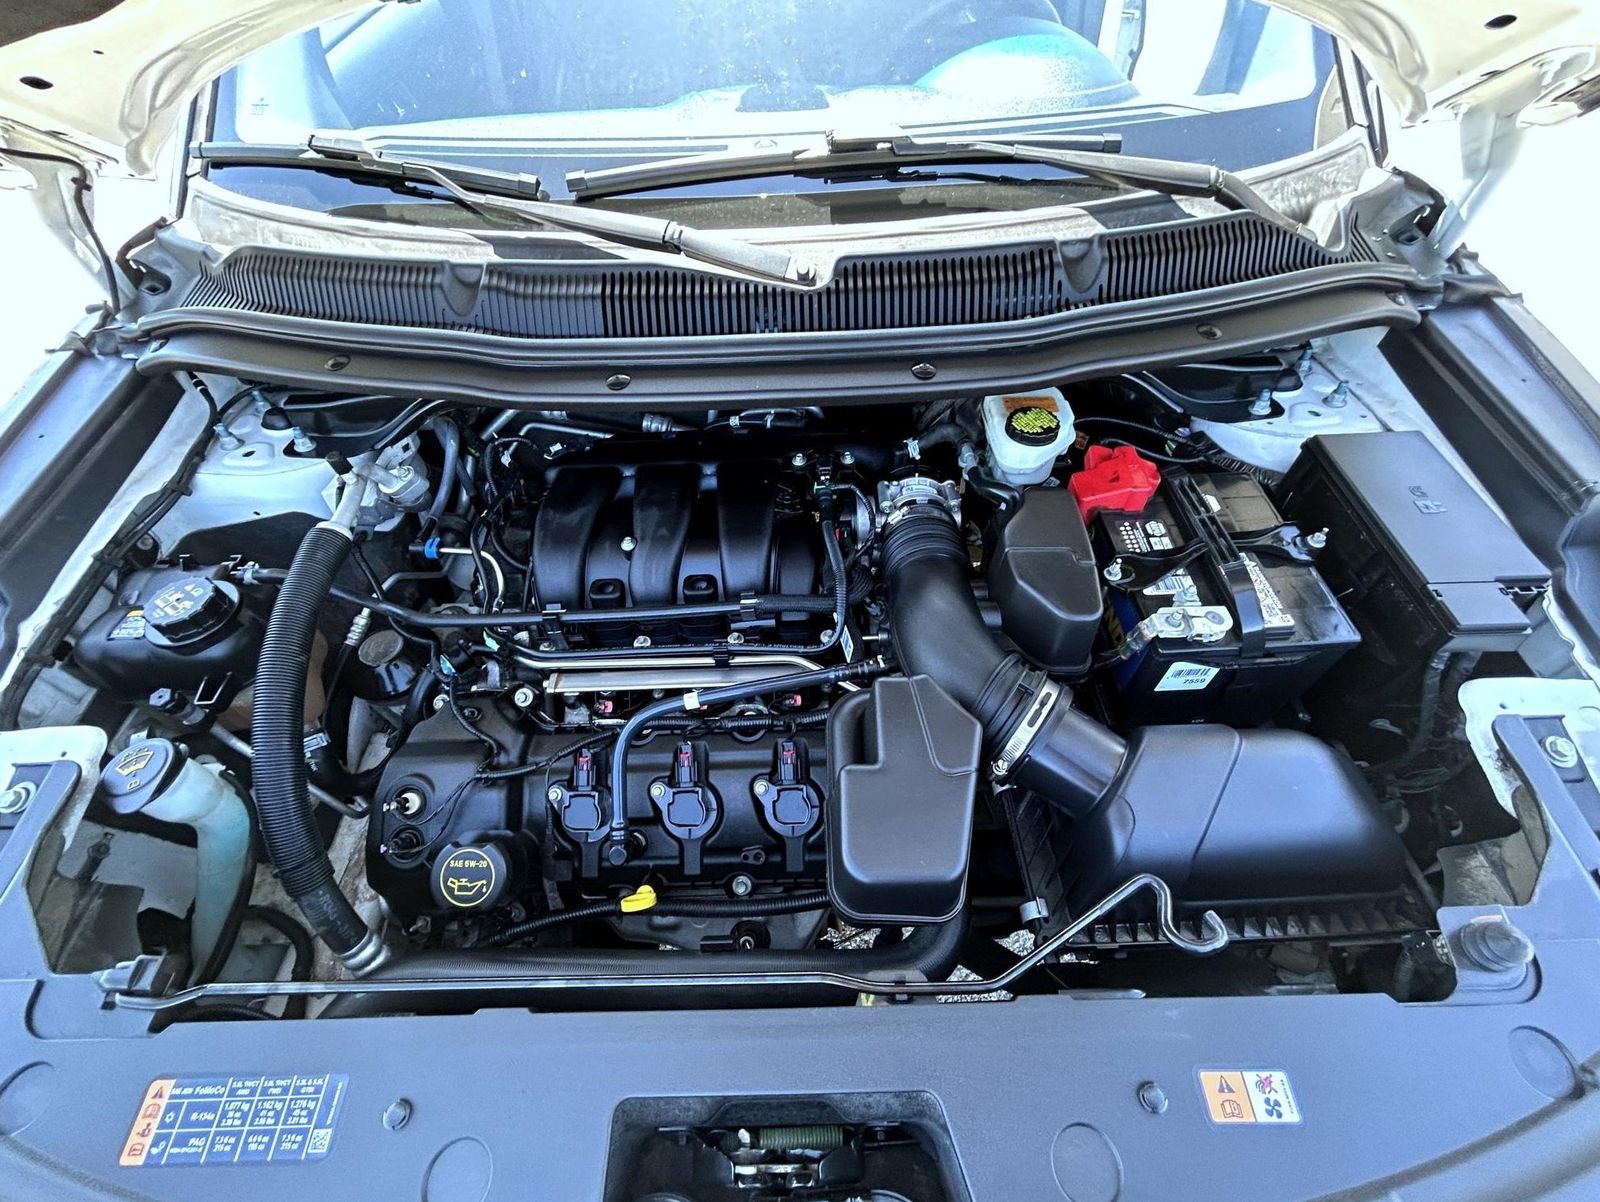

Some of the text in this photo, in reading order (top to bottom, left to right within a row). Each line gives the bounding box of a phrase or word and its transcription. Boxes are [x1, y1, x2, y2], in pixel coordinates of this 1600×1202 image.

[449, 859, 463, 868] SAE
[194, 1085, 225, 1096] FoMoCo
[242, 1102, 251, 1112] kg
[274, 1101, 283, 1111] kg
[307, 1100, 317, 1110] kg
[190, 1112, 216, 1121] R-134a
[188, 1137, 206, 1147] PAG
